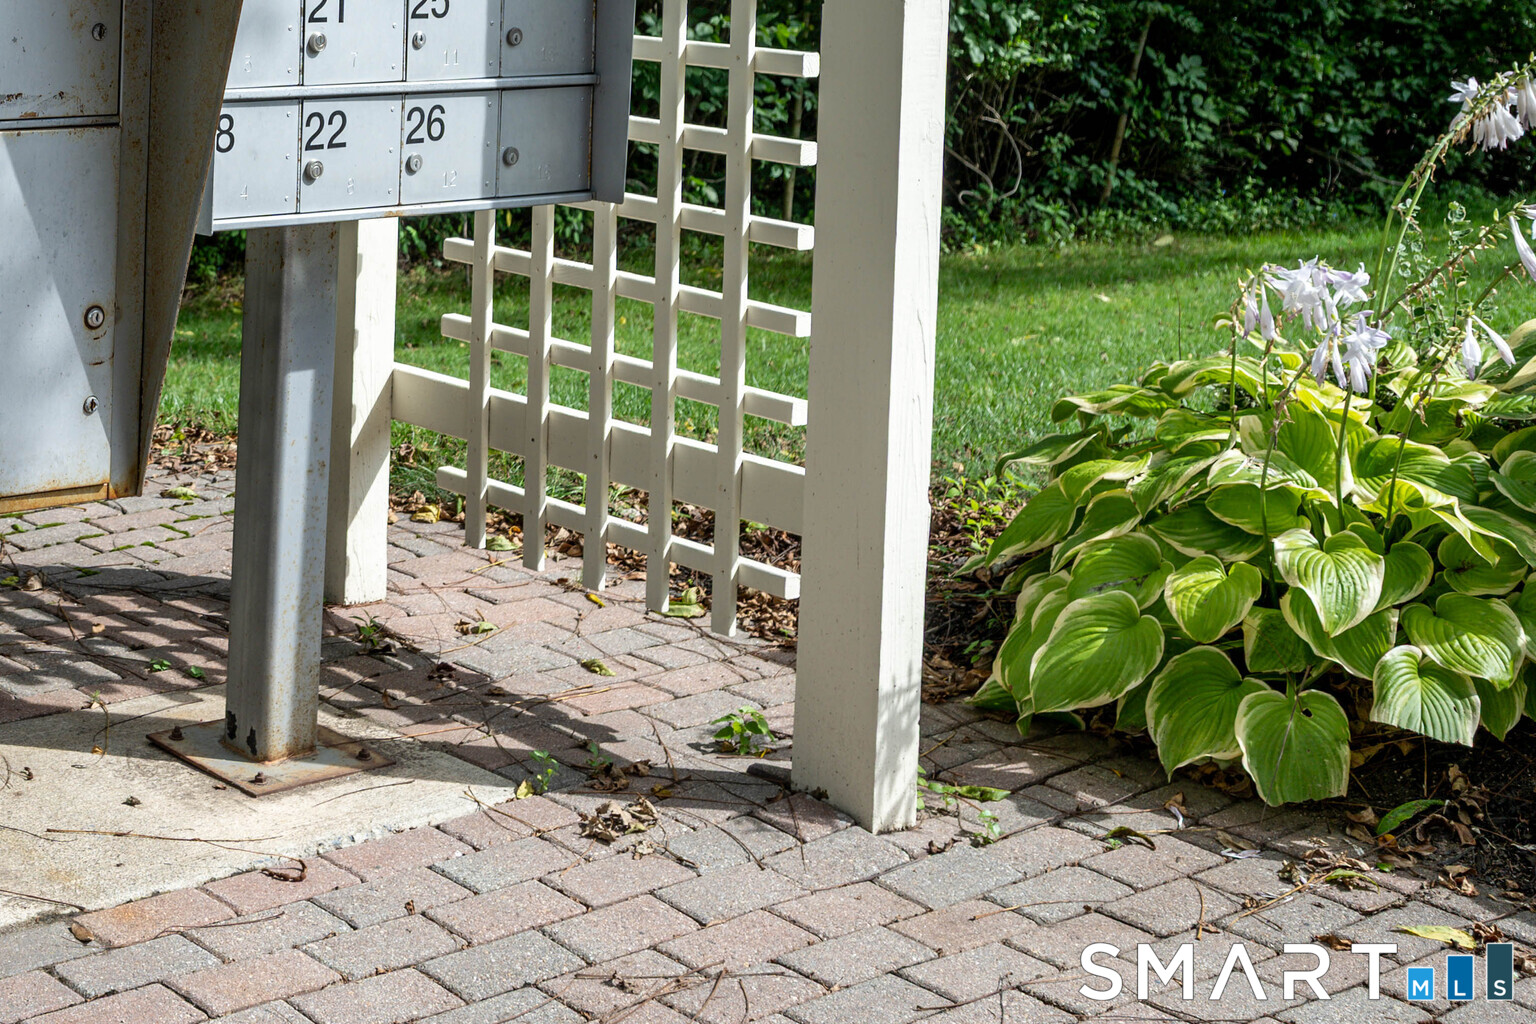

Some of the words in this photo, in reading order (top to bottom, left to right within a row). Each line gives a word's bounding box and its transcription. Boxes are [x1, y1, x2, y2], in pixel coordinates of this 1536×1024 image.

[350, 51, 359, 68] 7
[443, 49, 459, 66] 11
[215, 111, 235, 154] 8
[304, 109, 347, 152] 22
[405, 104, 446, 145] 26
[442, 170, 458, 188] 12
[239, 184, 249, 201] 4
